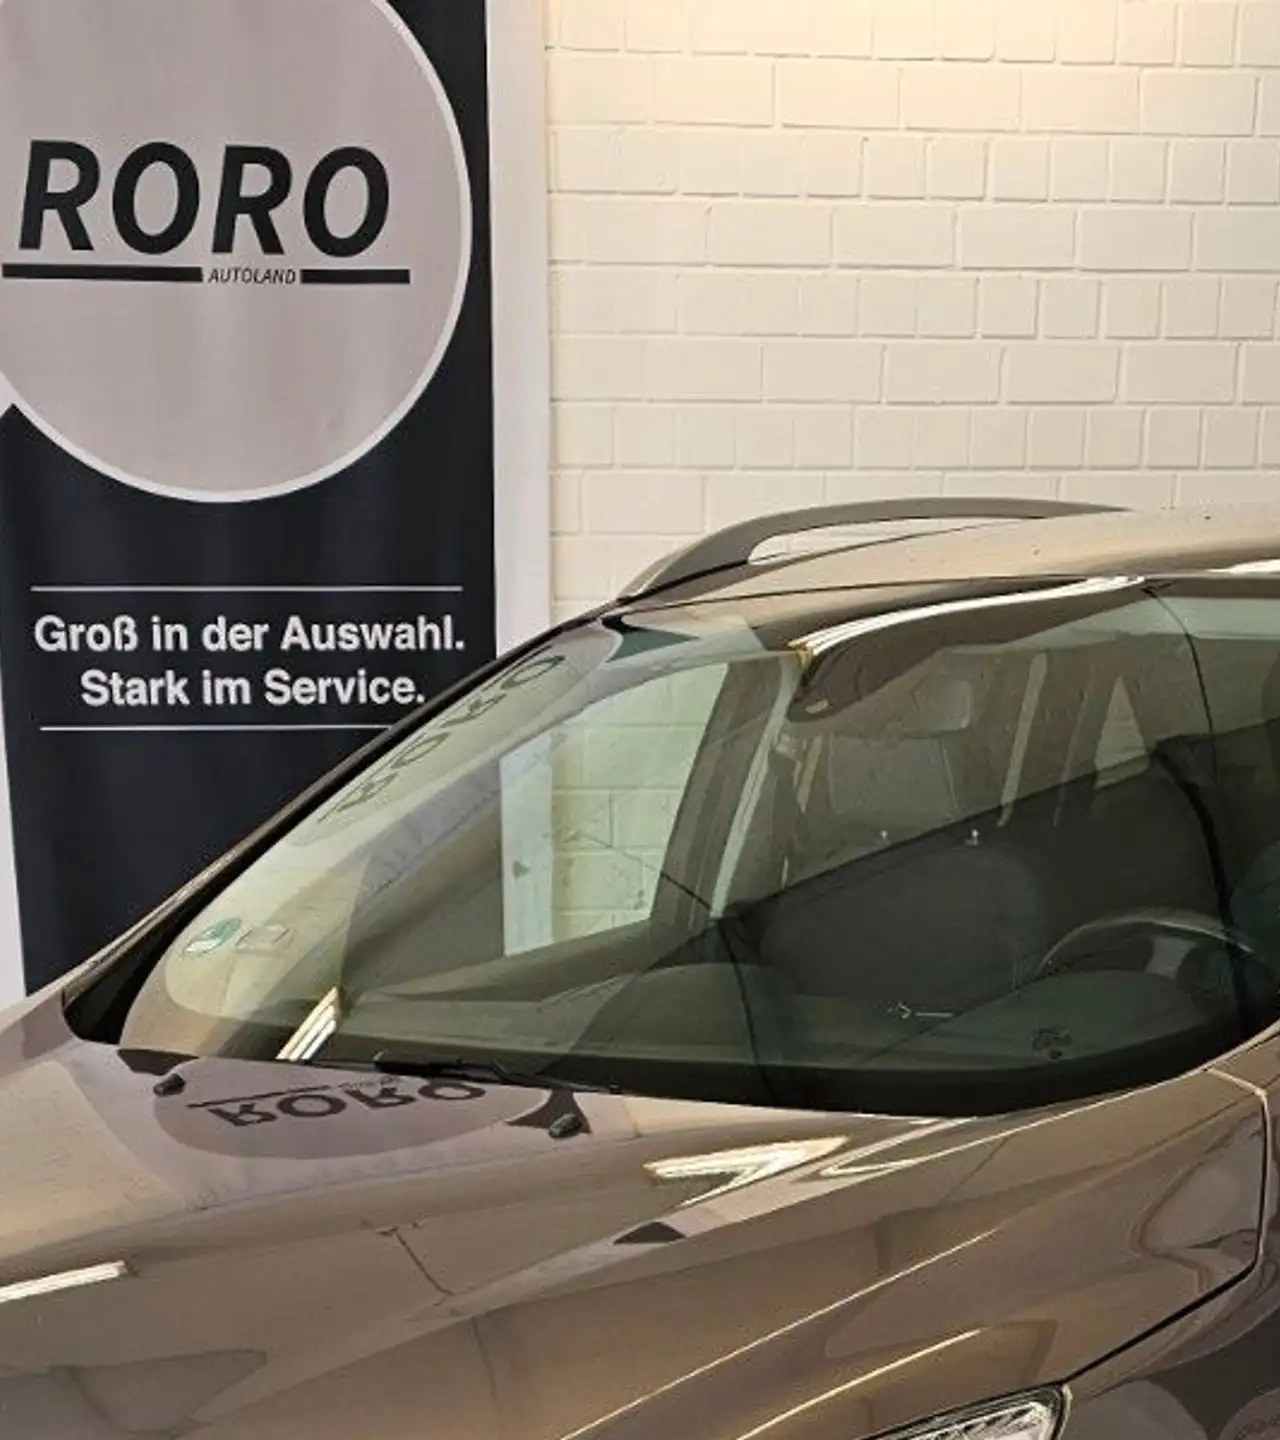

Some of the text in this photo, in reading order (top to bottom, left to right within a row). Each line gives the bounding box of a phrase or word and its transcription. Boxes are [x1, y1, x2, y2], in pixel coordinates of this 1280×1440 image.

[18, 139, 391, 258] RORO
[207, 267, 297, 285] AUTOLAND
[33, 614, 466, 652] Groß in der Auswahl.
[80, 667, 426, 706] Stark im Service.
